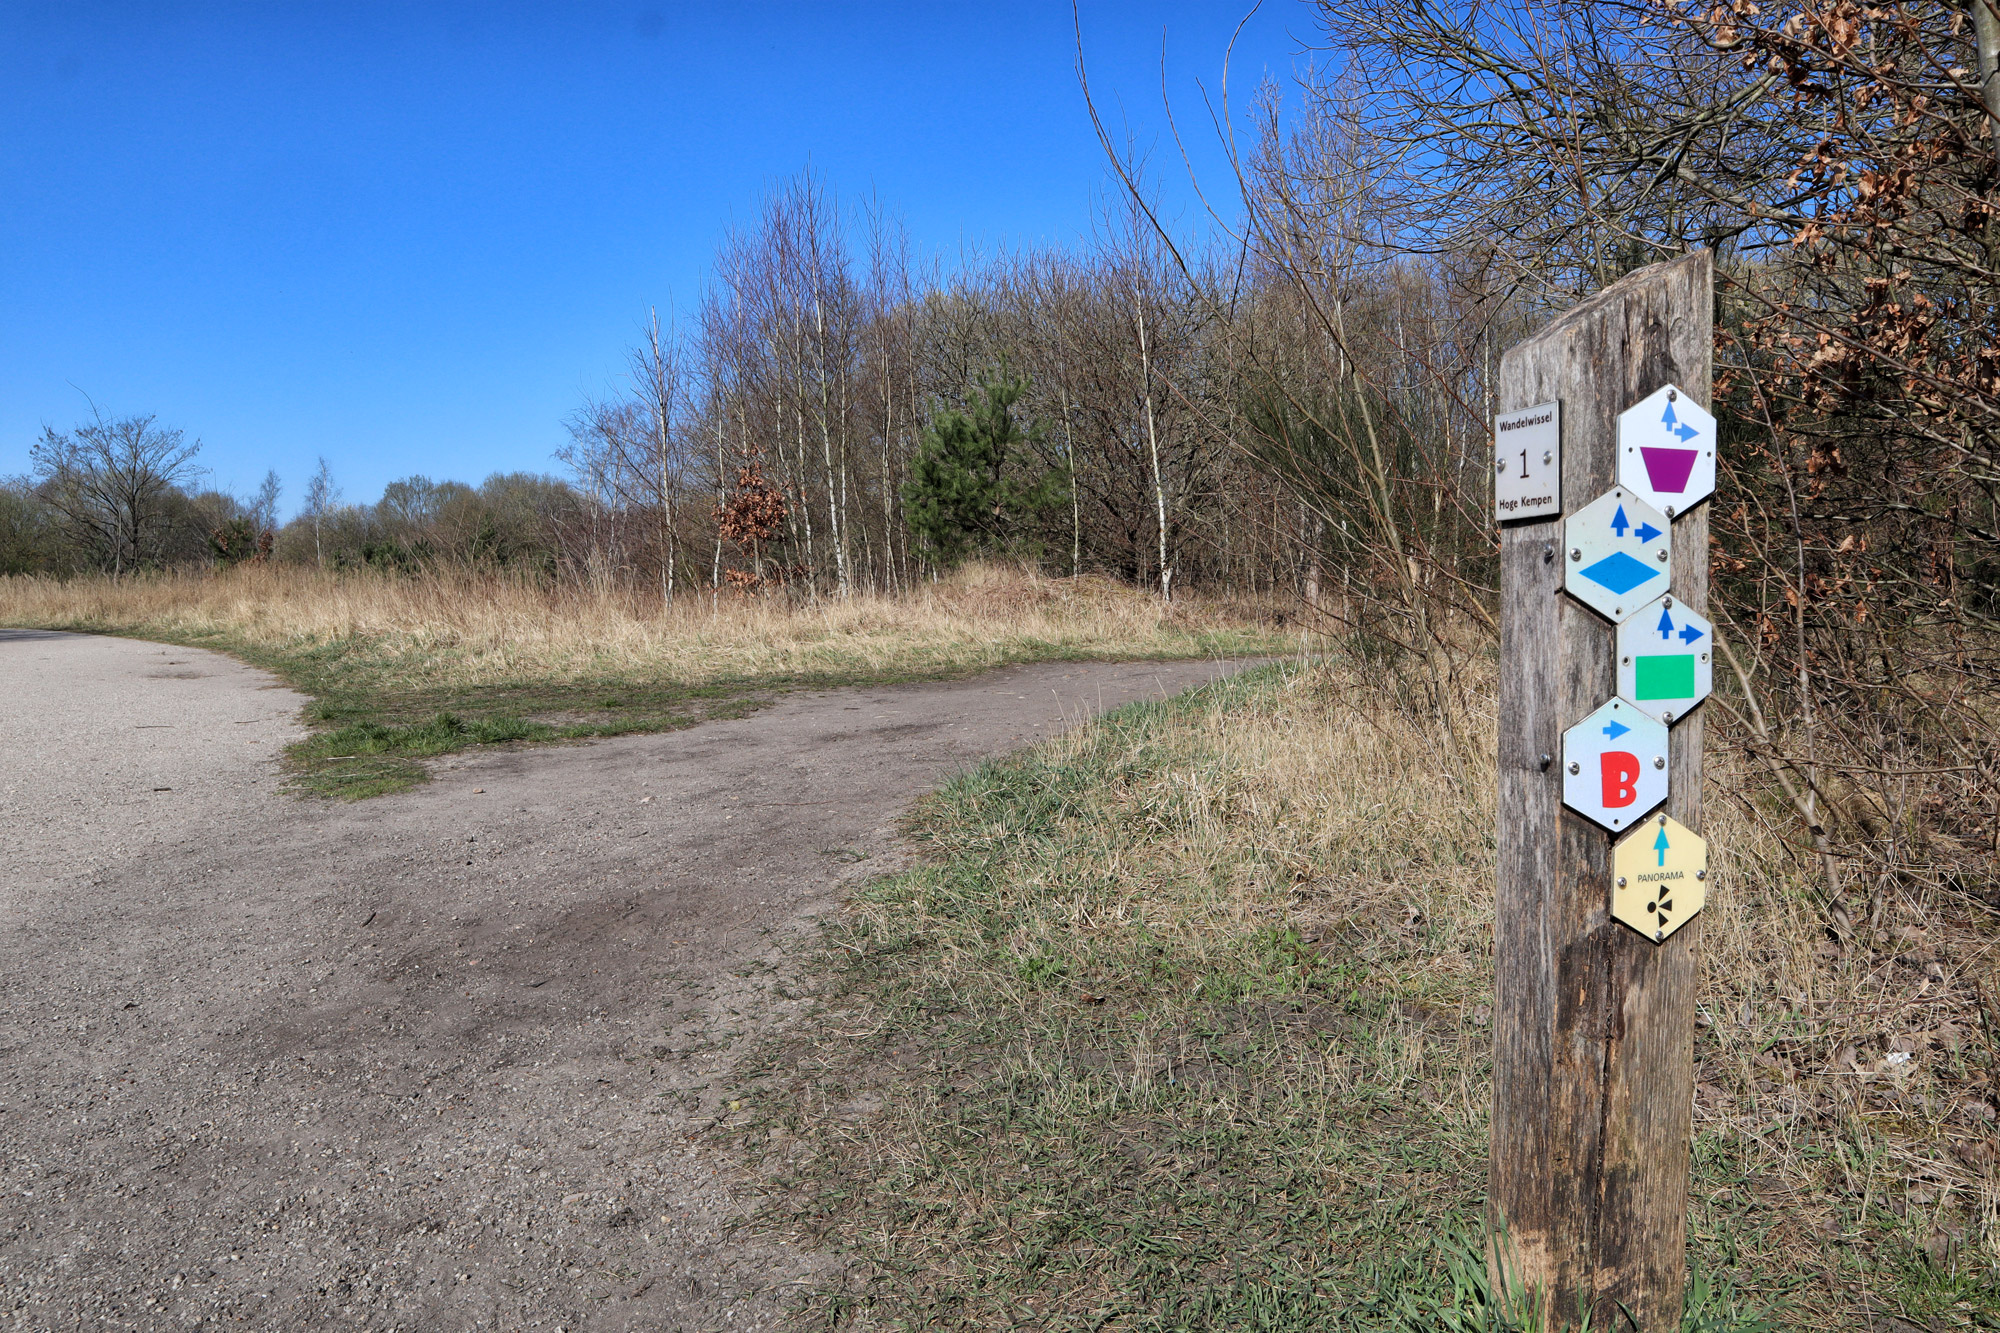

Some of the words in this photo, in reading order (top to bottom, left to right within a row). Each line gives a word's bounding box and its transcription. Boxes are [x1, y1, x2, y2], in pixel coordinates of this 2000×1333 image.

[1499, 411, 1552, 432] Wandelwissel
[1520, 448, 1530, 479] 1
[1499, 499, 1518, 512] Hoge
[1521, 495, 1552, 508] Kempen
[1600, 751, 1640, 808] B
[1637, 870, 1685, 883] PANORAMA
